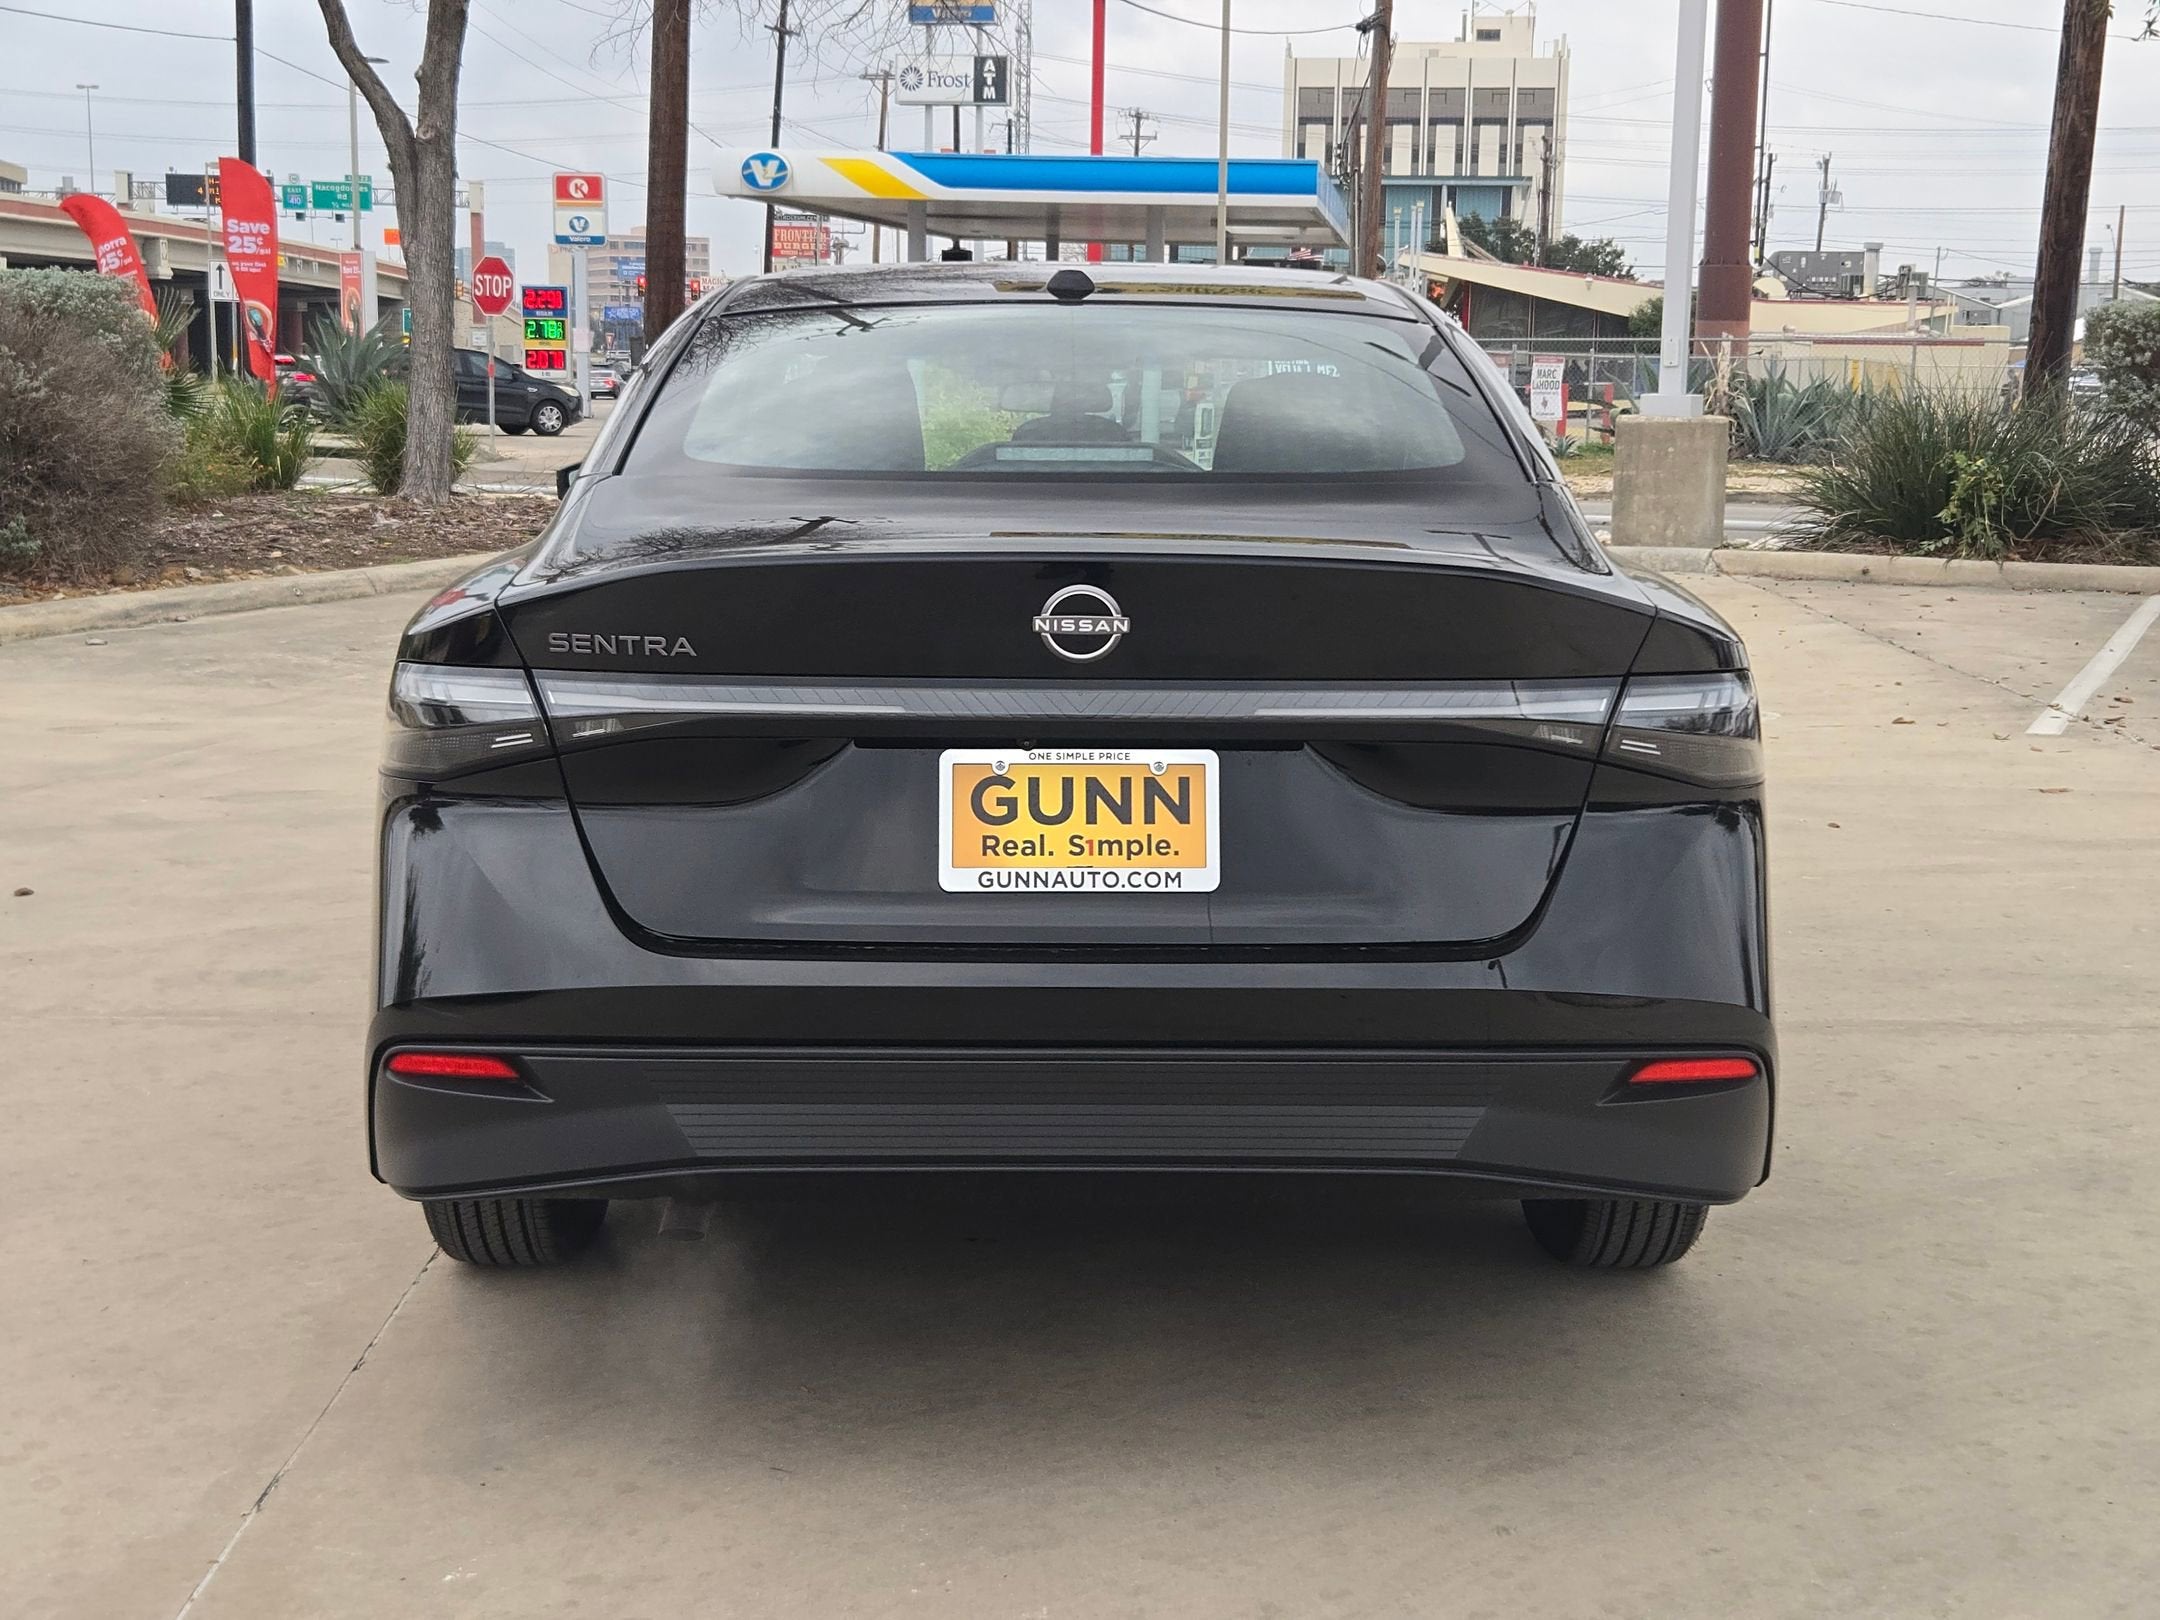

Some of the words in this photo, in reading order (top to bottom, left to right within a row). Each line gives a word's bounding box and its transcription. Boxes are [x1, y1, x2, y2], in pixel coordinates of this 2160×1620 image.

[927, 71, 971, 88] Frost
[983, 59, 996, 99] ATM
[227, 219, 271, 234] Save
[474, 275, 512, 298] STOP
[1536, 369, 1557, 379] MARC
[1034, 618, 1128, 632] NISSAN
[549, 632, 698, 657] SENTRA
[1028, 752, 1053, 761] ONE
[1056, 752, 1095, 761] SIMPLE
[1099, 752, 1131, 761] PRICE
[970, 775, 1191, 826] GUNN
[981, 833, 1054, 857] Real.
[978, 871, 1182, 889] GUNNAUTO.COM
